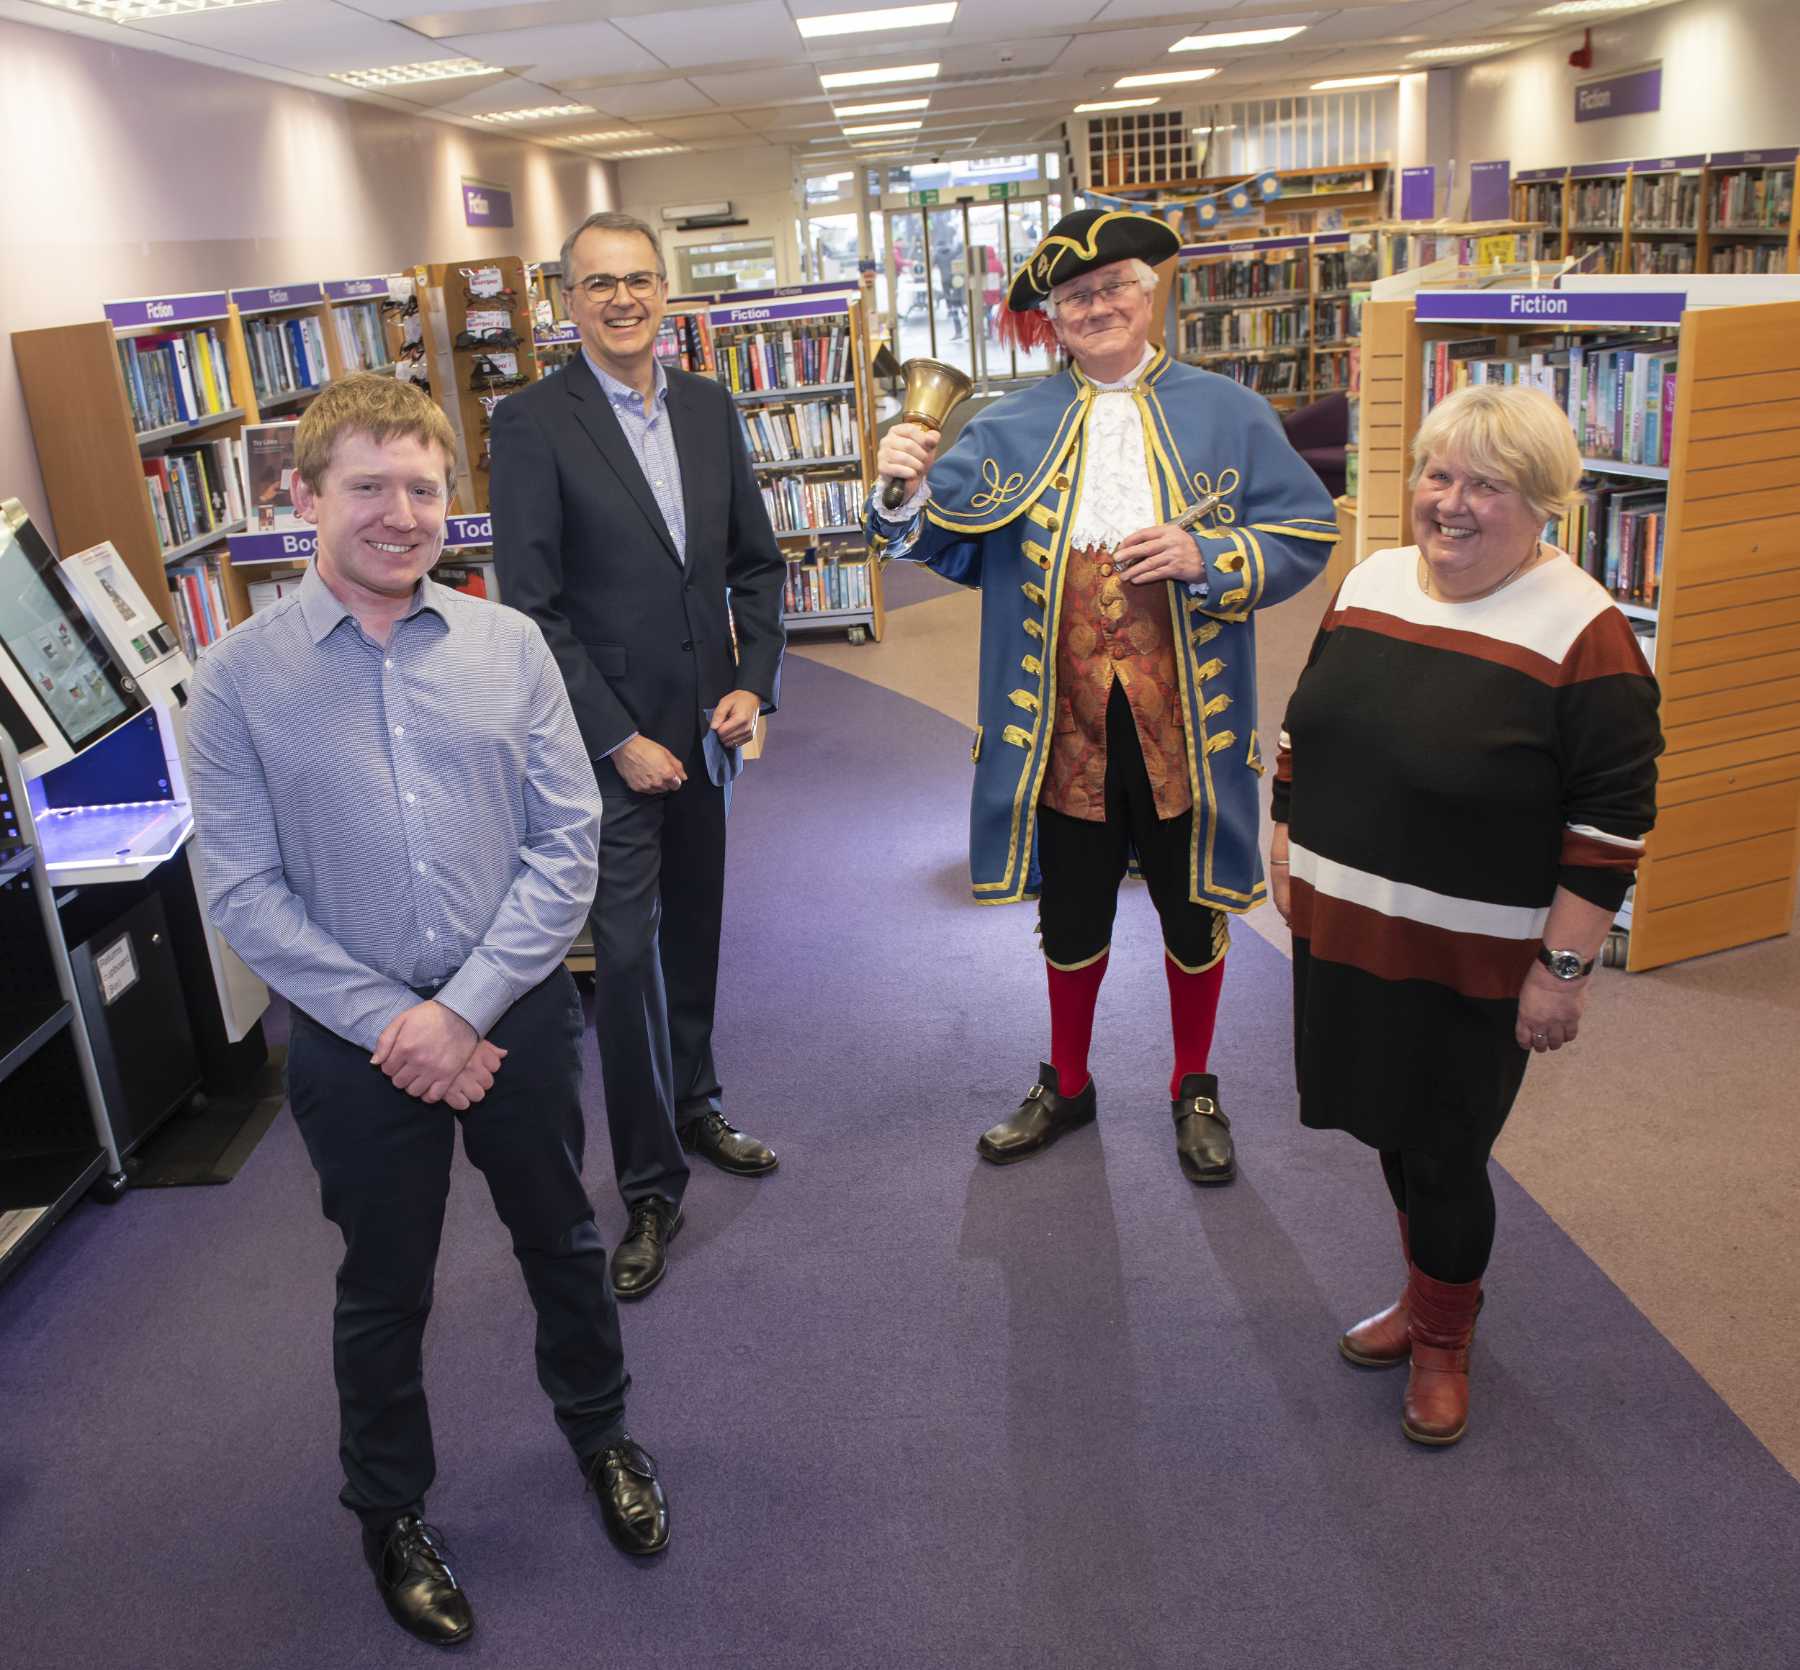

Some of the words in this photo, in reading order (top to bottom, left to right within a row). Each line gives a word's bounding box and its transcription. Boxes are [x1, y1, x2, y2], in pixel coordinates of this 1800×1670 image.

[1580, 90, 1611, 111] Fiction
[773, 287, 803, 297] Fiction
[145, 301, 175, 320] Fiction
[730, 306, 770, 321] Fiction
[1510, 294, 1568, 314] Fiction
